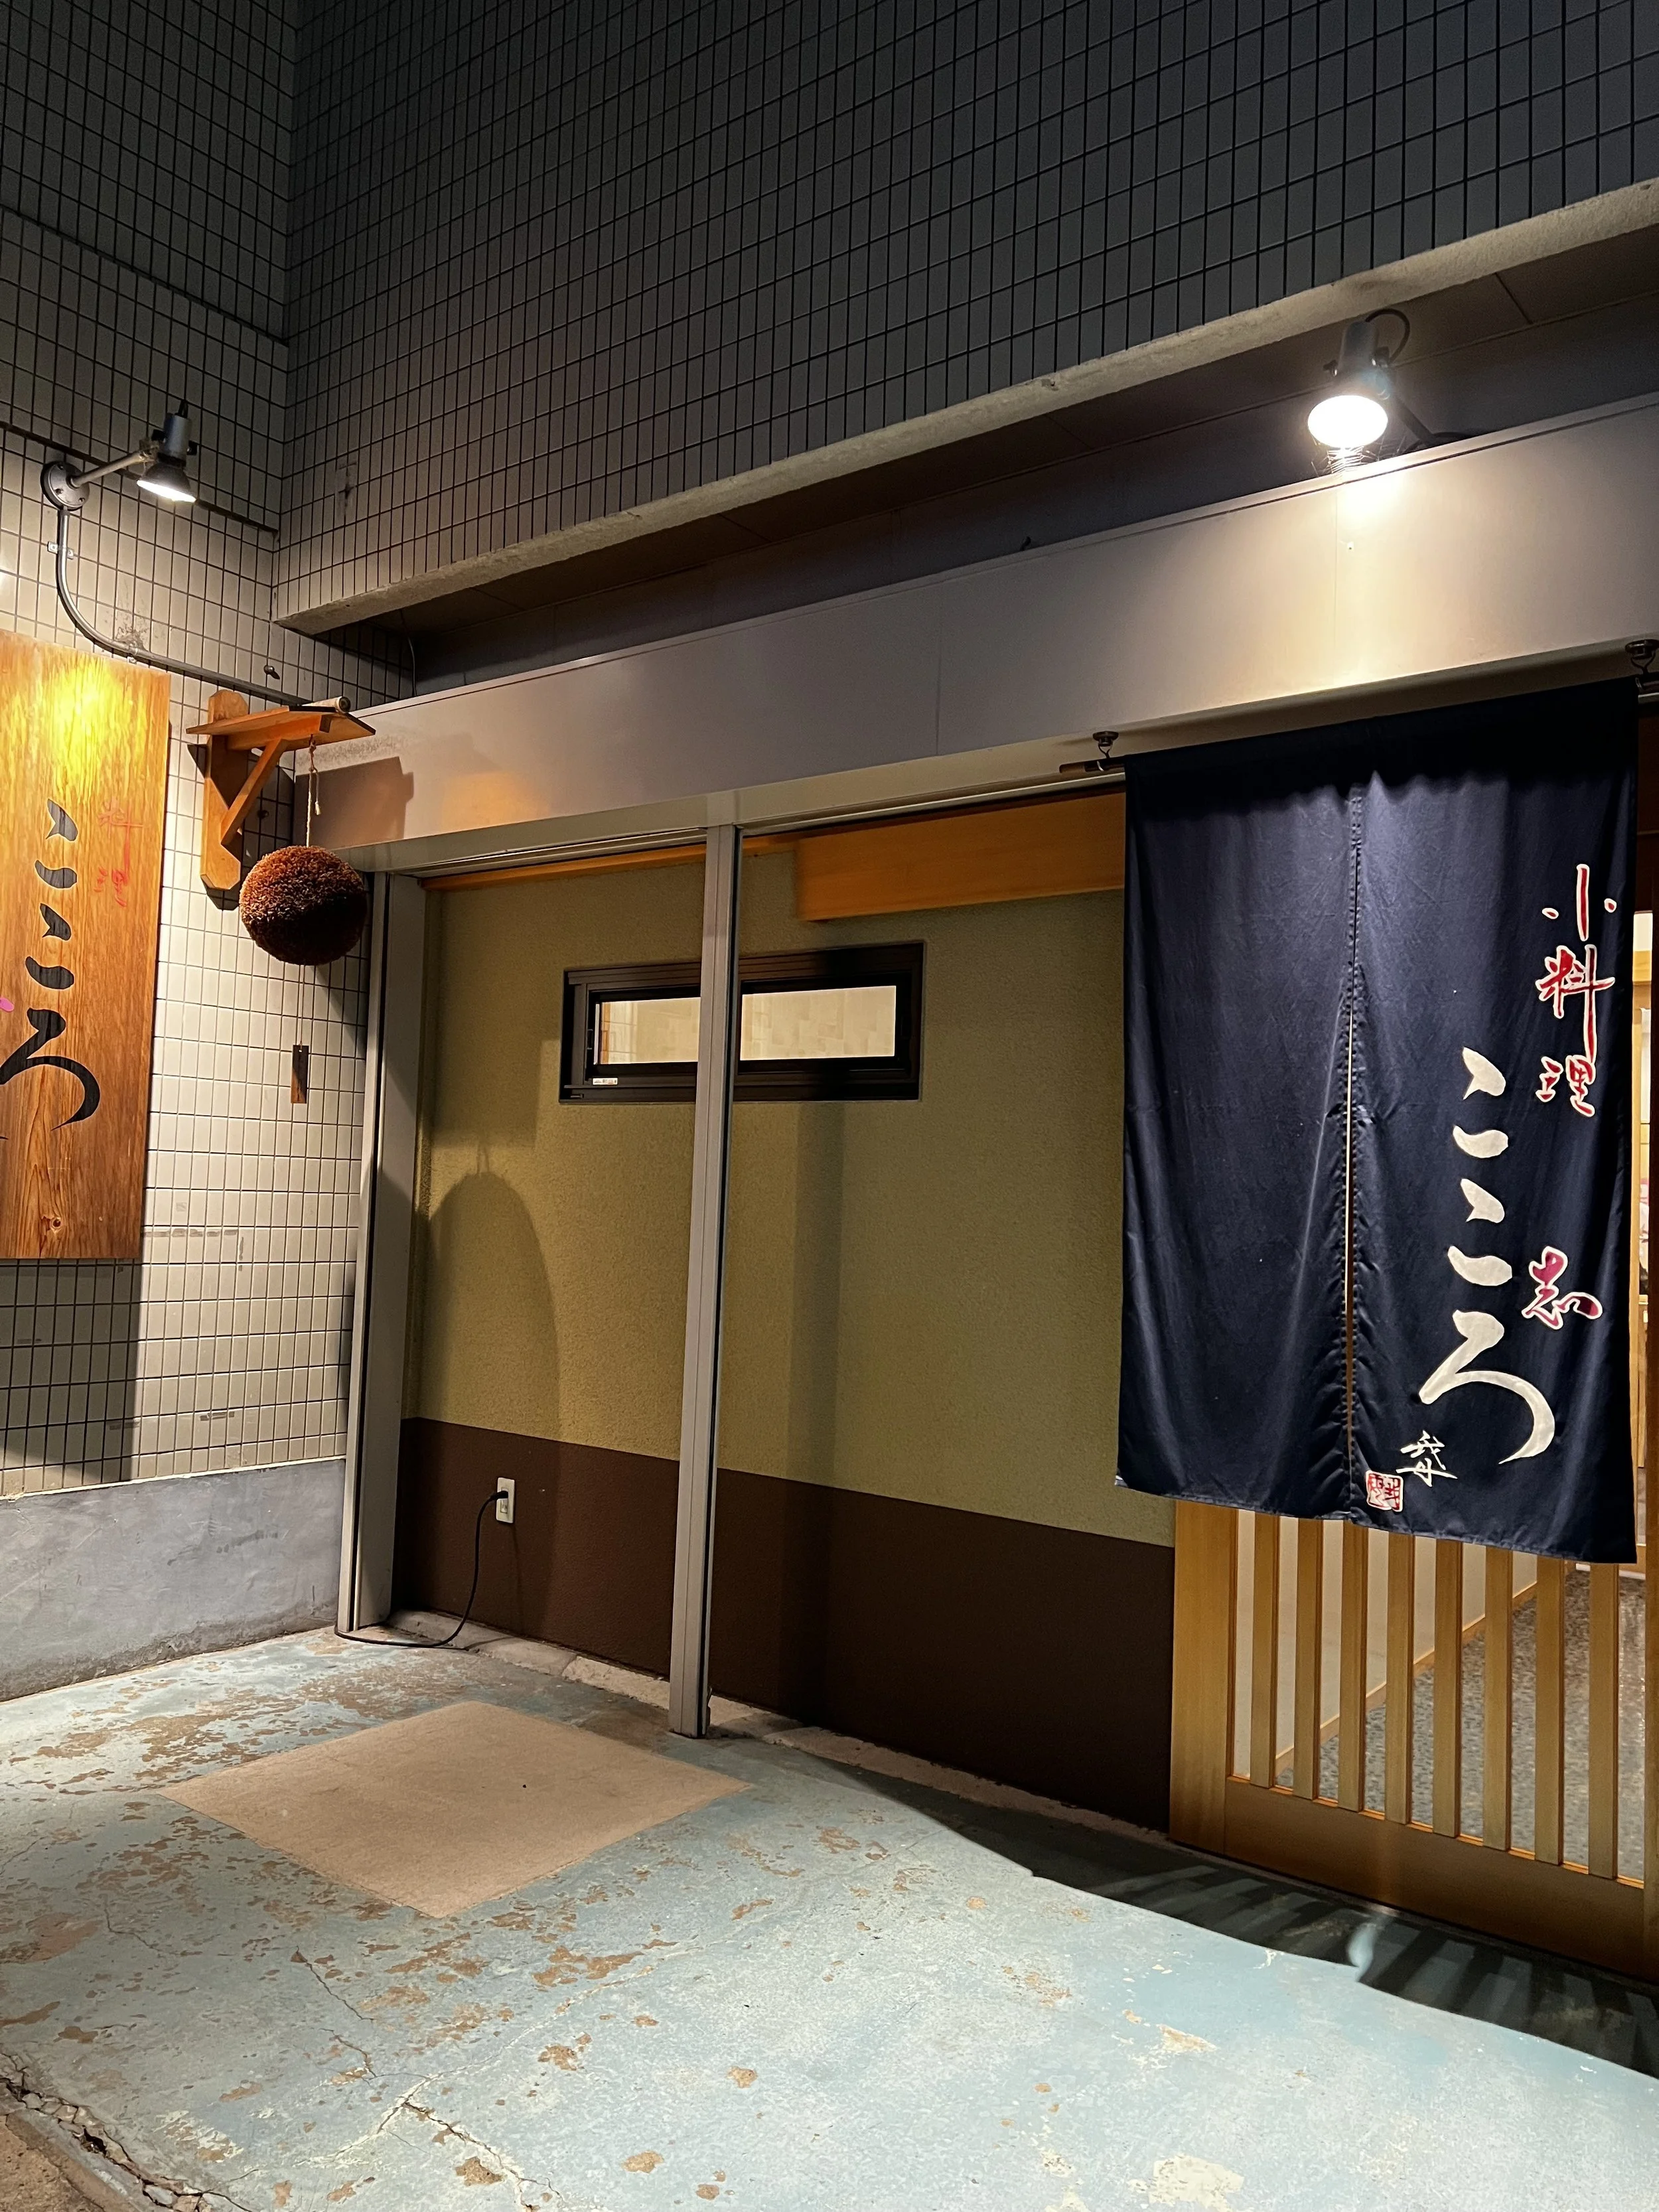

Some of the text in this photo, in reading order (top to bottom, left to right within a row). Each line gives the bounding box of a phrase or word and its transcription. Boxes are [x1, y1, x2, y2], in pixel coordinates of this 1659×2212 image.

[0, 798, 101, 1132] こころ
[1535, 863, 1617, 1118] 小料理
[1419, 1047, 1555, 1465] こころ
